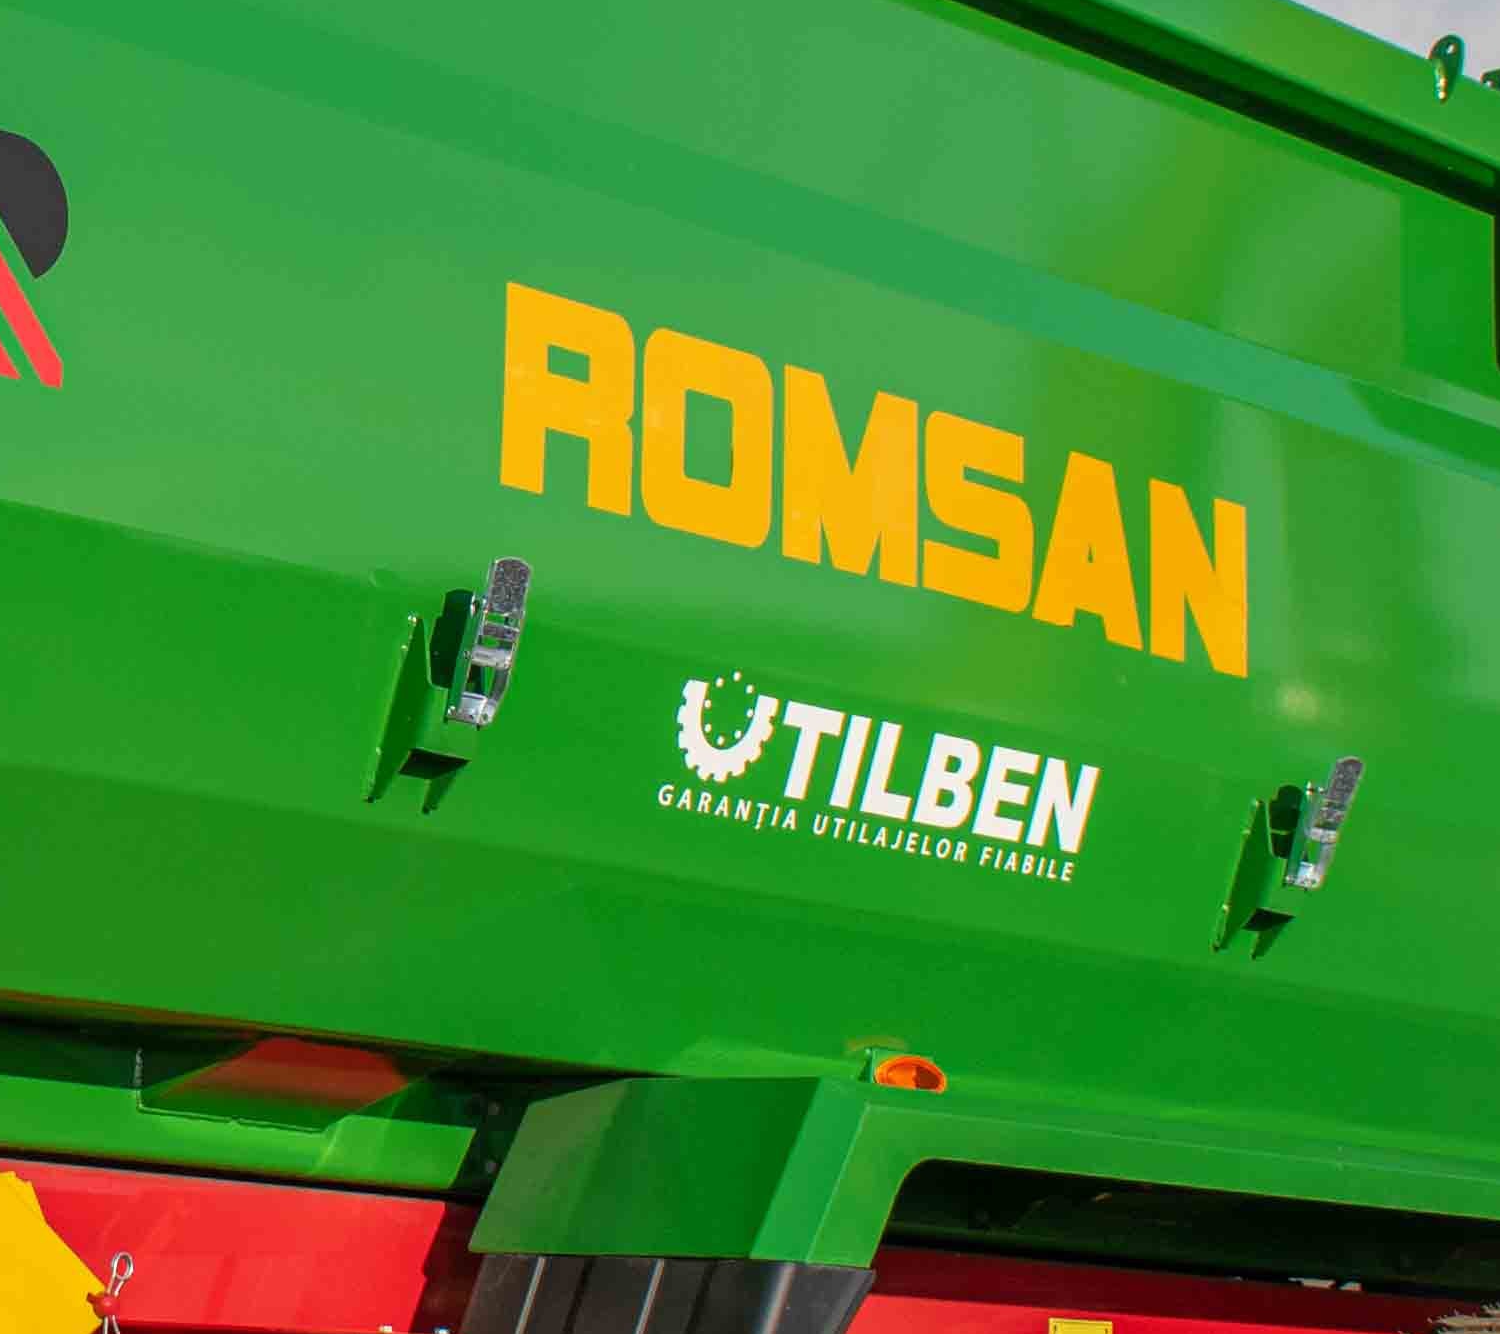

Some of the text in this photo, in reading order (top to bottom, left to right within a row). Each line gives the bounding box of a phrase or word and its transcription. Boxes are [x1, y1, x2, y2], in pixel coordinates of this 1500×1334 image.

[500, 281, 1249, 678] ROMSAN
[676, 677, 1101, 854] UTILBEN
[812, 814, 969, 863] UTILAJELOR
[979, 845, 1076, 884] FIABILE
